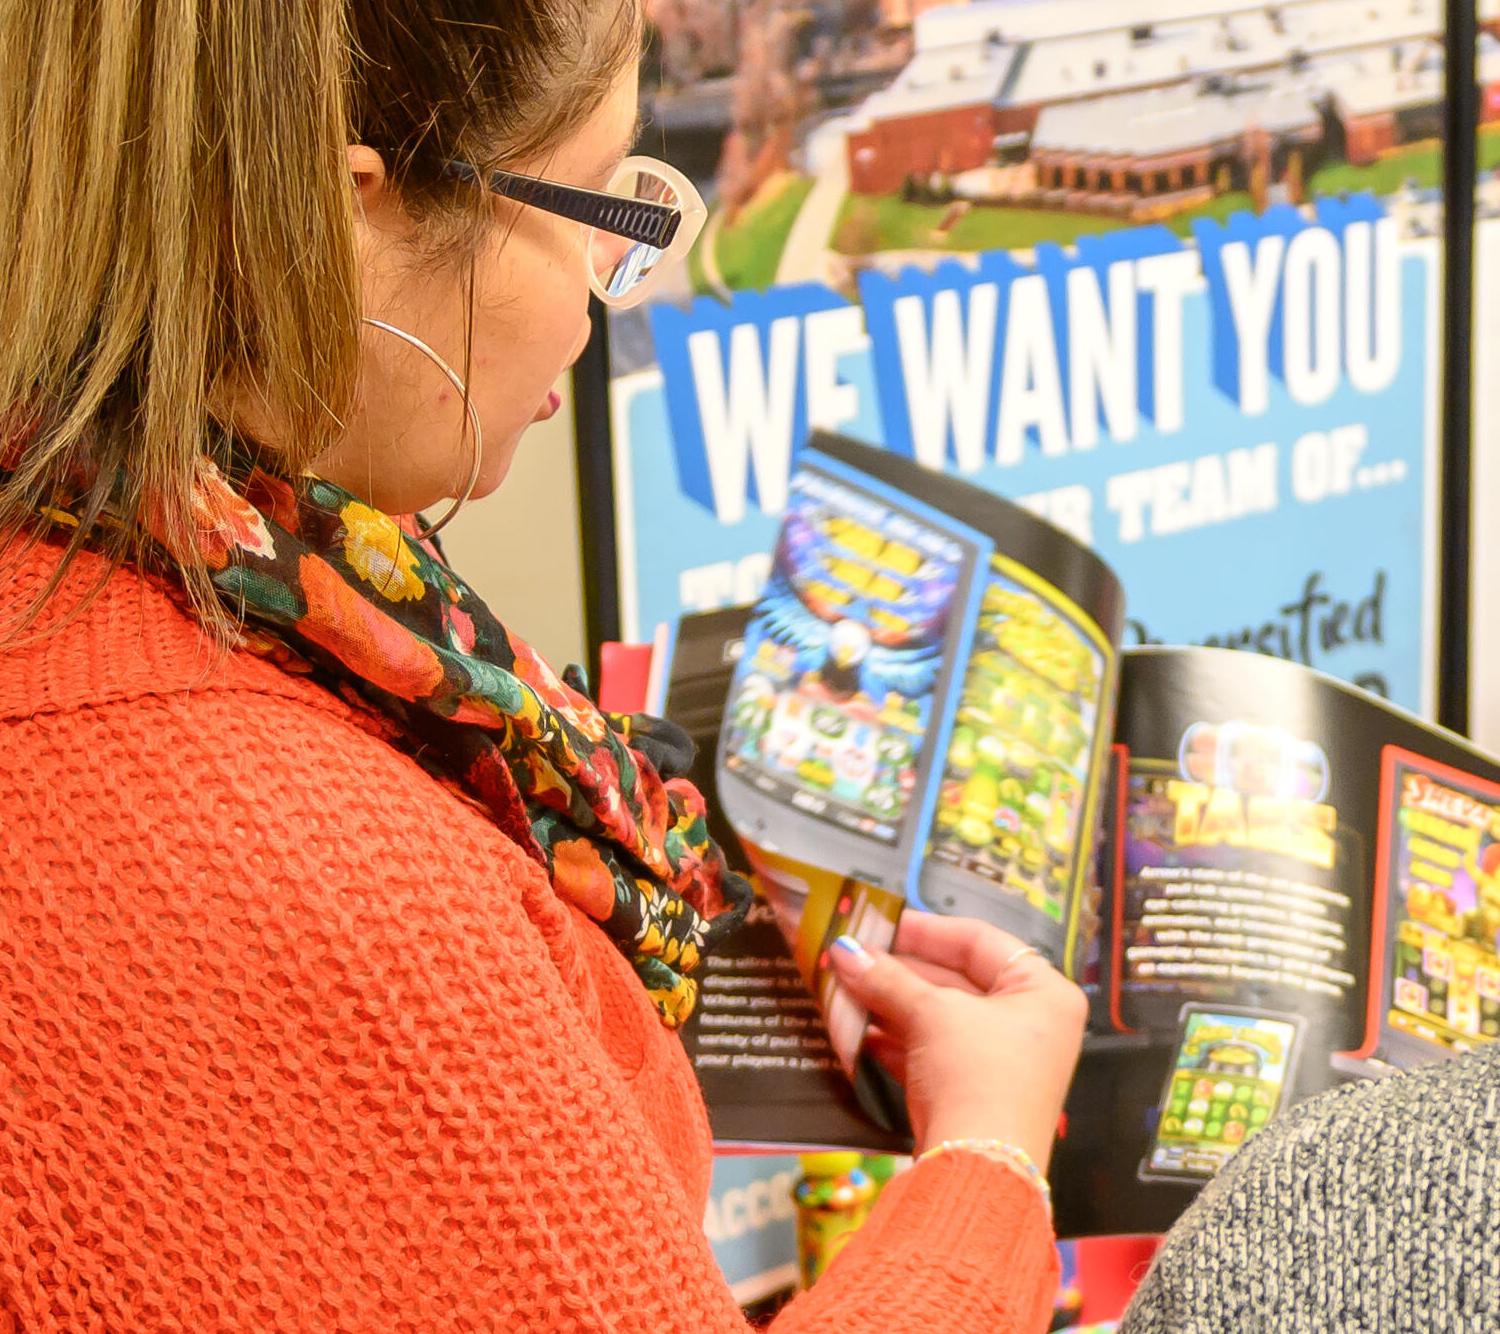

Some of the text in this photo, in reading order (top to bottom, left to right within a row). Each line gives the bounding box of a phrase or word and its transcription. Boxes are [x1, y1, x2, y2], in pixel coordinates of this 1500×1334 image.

[688, 305, 871, 525] WE
[894, 247, 1208, 474] WANT
[1220, 216, 1401, 417] YOU
[1107, 442, 1279, 545] TEAM
